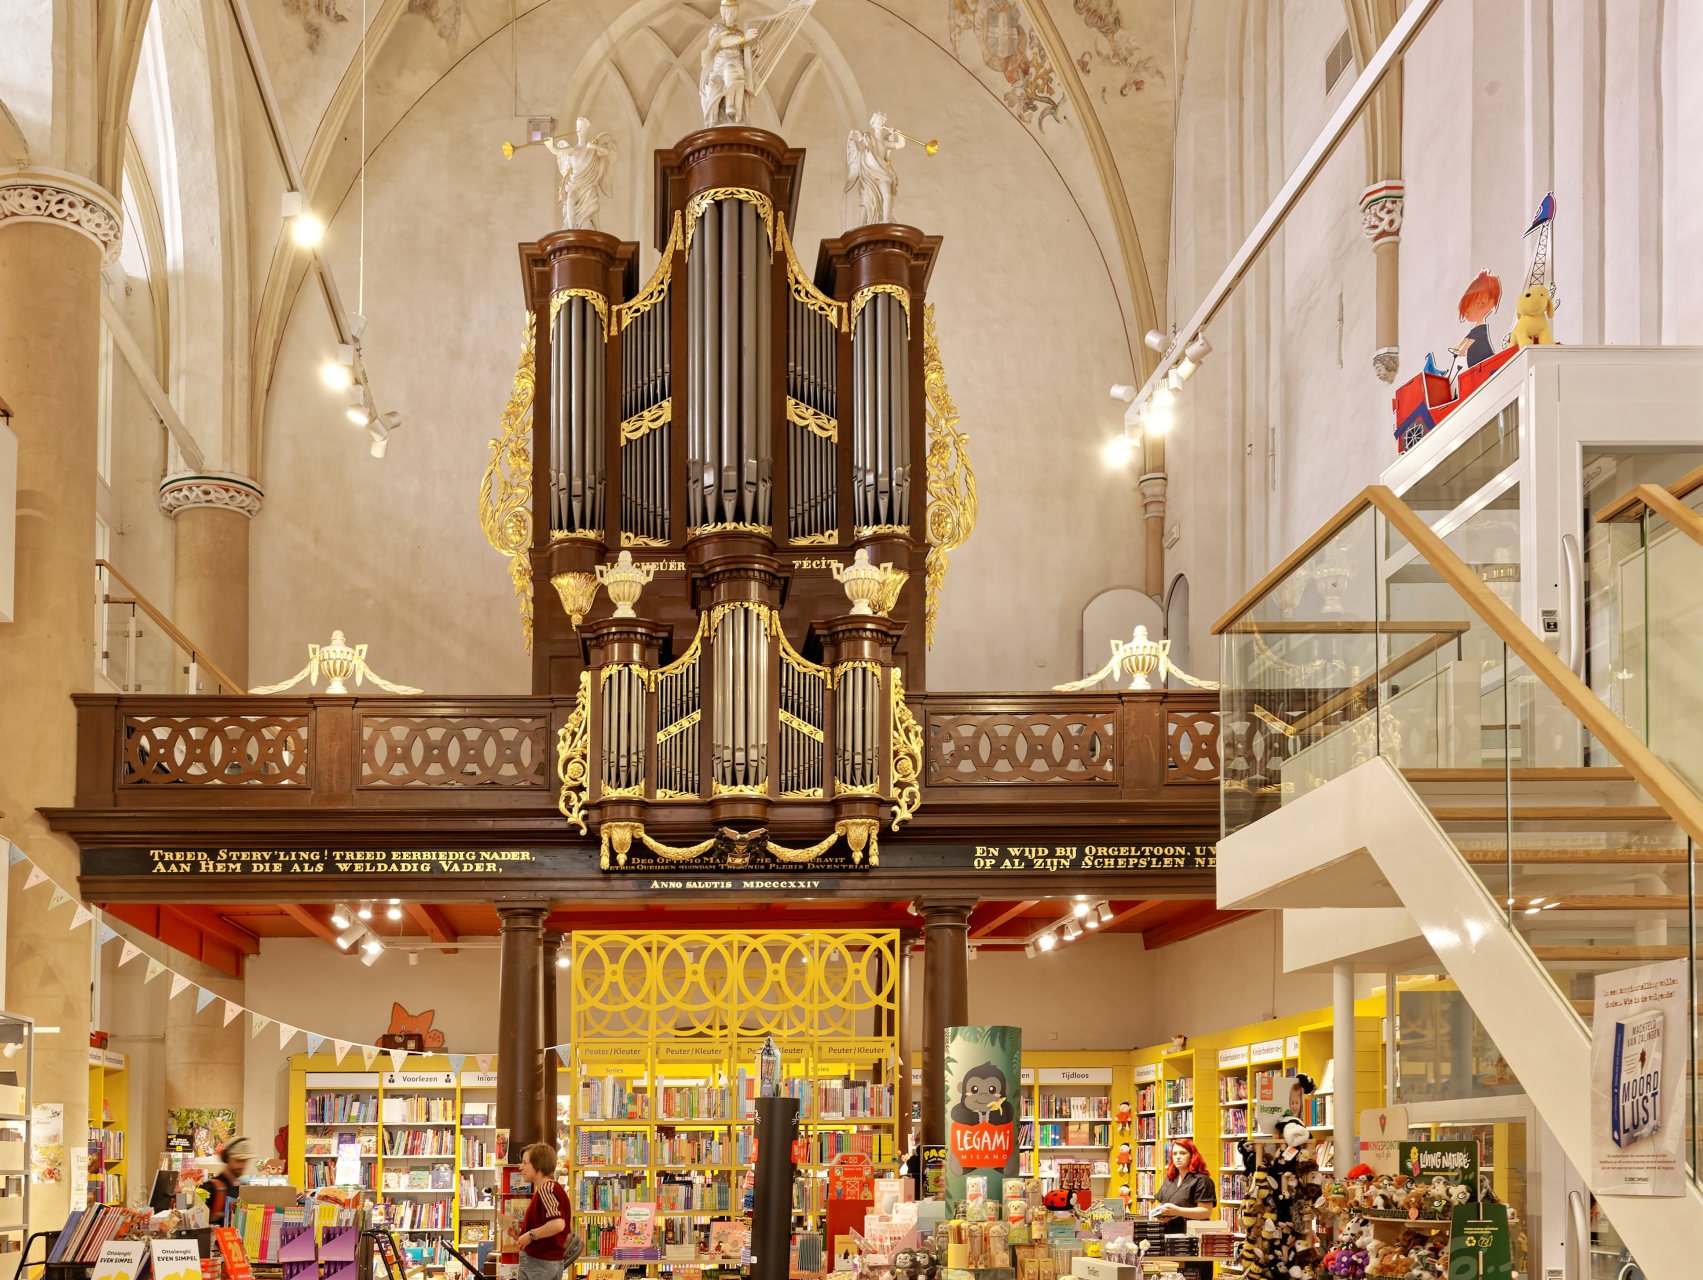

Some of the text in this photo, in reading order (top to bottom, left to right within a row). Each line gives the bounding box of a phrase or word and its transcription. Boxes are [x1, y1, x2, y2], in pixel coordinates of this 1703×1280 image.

[150, 850, 210, 861] TREED,
[333, 852, 386, 861] TREED
[391, 852, 476, 861] EERBIEDIG
[480, 852, 536, 862] NADER,
[975, 846, 999, 856] EN
[1007, 847, 1049, 859] WIJD
[1055, 847, 1077, 859] BIJ
[152, 861, 503, 873] AAN HEM DIE ALS WELDADIG VADER,
[973, 858, 996, 869] OP
[1000, 859, 1024, 869] AL
[1034, 858, 1070, 871] ZIJN
[1195, 858, 1216, 868] NE
[651, 880, 682, 889] ANNO
[1062, 1072, 1089, 1080] Tijdloos
[1622, 1071, 1659, 1103] MOORD
[1622, 1091, 1659, 1135] LUST
[1420, 1151, 1441, 1169] LIVING
